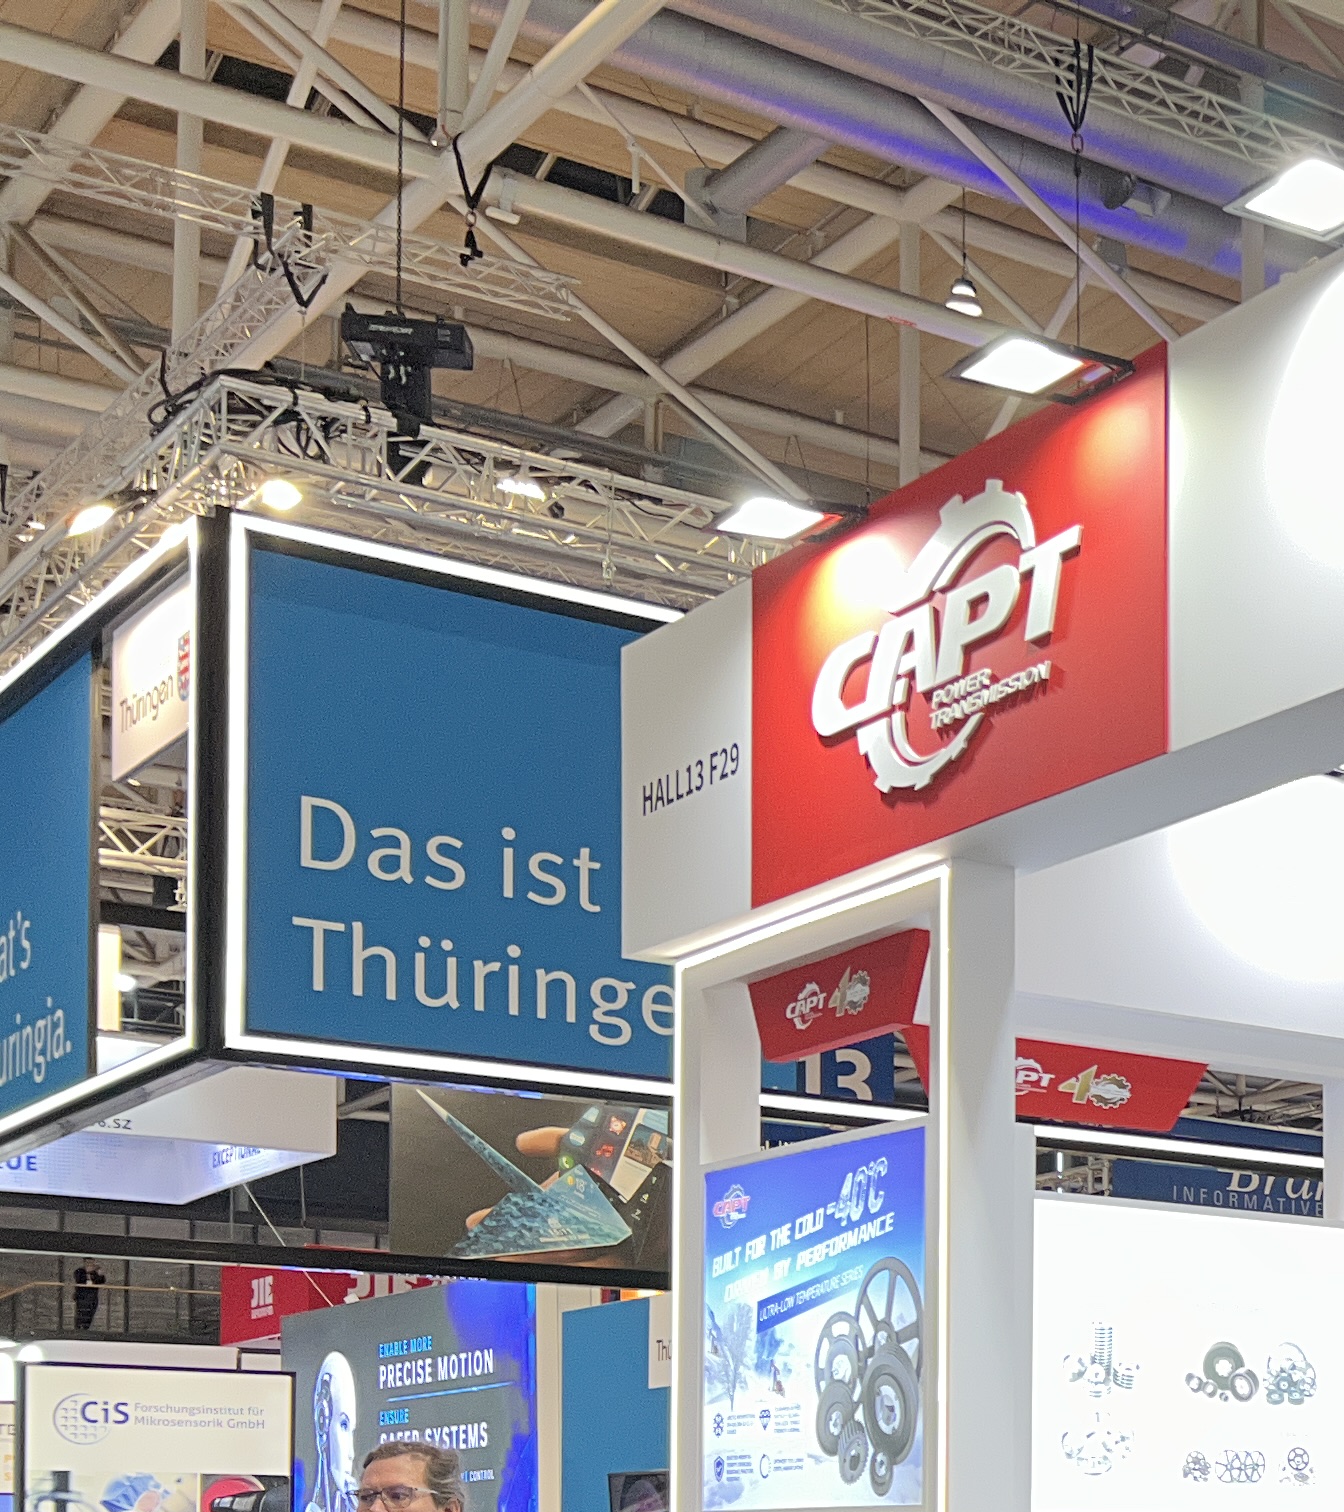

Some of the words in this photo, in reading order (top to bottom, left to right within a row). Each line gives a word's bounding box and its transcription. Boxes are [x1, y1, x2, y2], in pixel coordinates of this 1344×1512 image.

[812, 525, 1083, 737] CAPT
[930, 661, 1052, 729] TRANSMISSION
[931, 668, 993, 707] POWER
[642, 760, 704, 816] HALL13
[709, 743, 740, 786] F29
[300, 795, 466, 891] Das
[502, 827, 602, 914] ist
[292, 915, 675, 1046] Thüringe
[785, 992, 827, 1020] CAPT
[1173, 1184, 1324, 1217] INFORMATIVE
[712, 1246, 742, 1279] BUILT
[745, 1234, 768, 1263] FOR
[770, 1223, 792, 1252] THE
[794, 1207, 825, 1241] COLD
[795, 1211, 896, 1272] PERFORMANCE
[379, 1338, 408, 1358] ENABLE
[410, 1335, 433, 1352] MORE
[379, 1358, 432, 1390] PRECISE
[437, 1348, 495, 1382] MOTION
[80, 1401, 129, 1425] CiS
[134, 1402, 245, 1419] Forschungsinstitut
[247, 1405, 265, 1417] für
[134, 1415, 223, 1429] Mikrosensorik
[227, 1417, 266, 1430] GmbH
[379, 1407, 410, 1426] ENSURE
[424, 1421, 489, 1450] SYSTEMS
